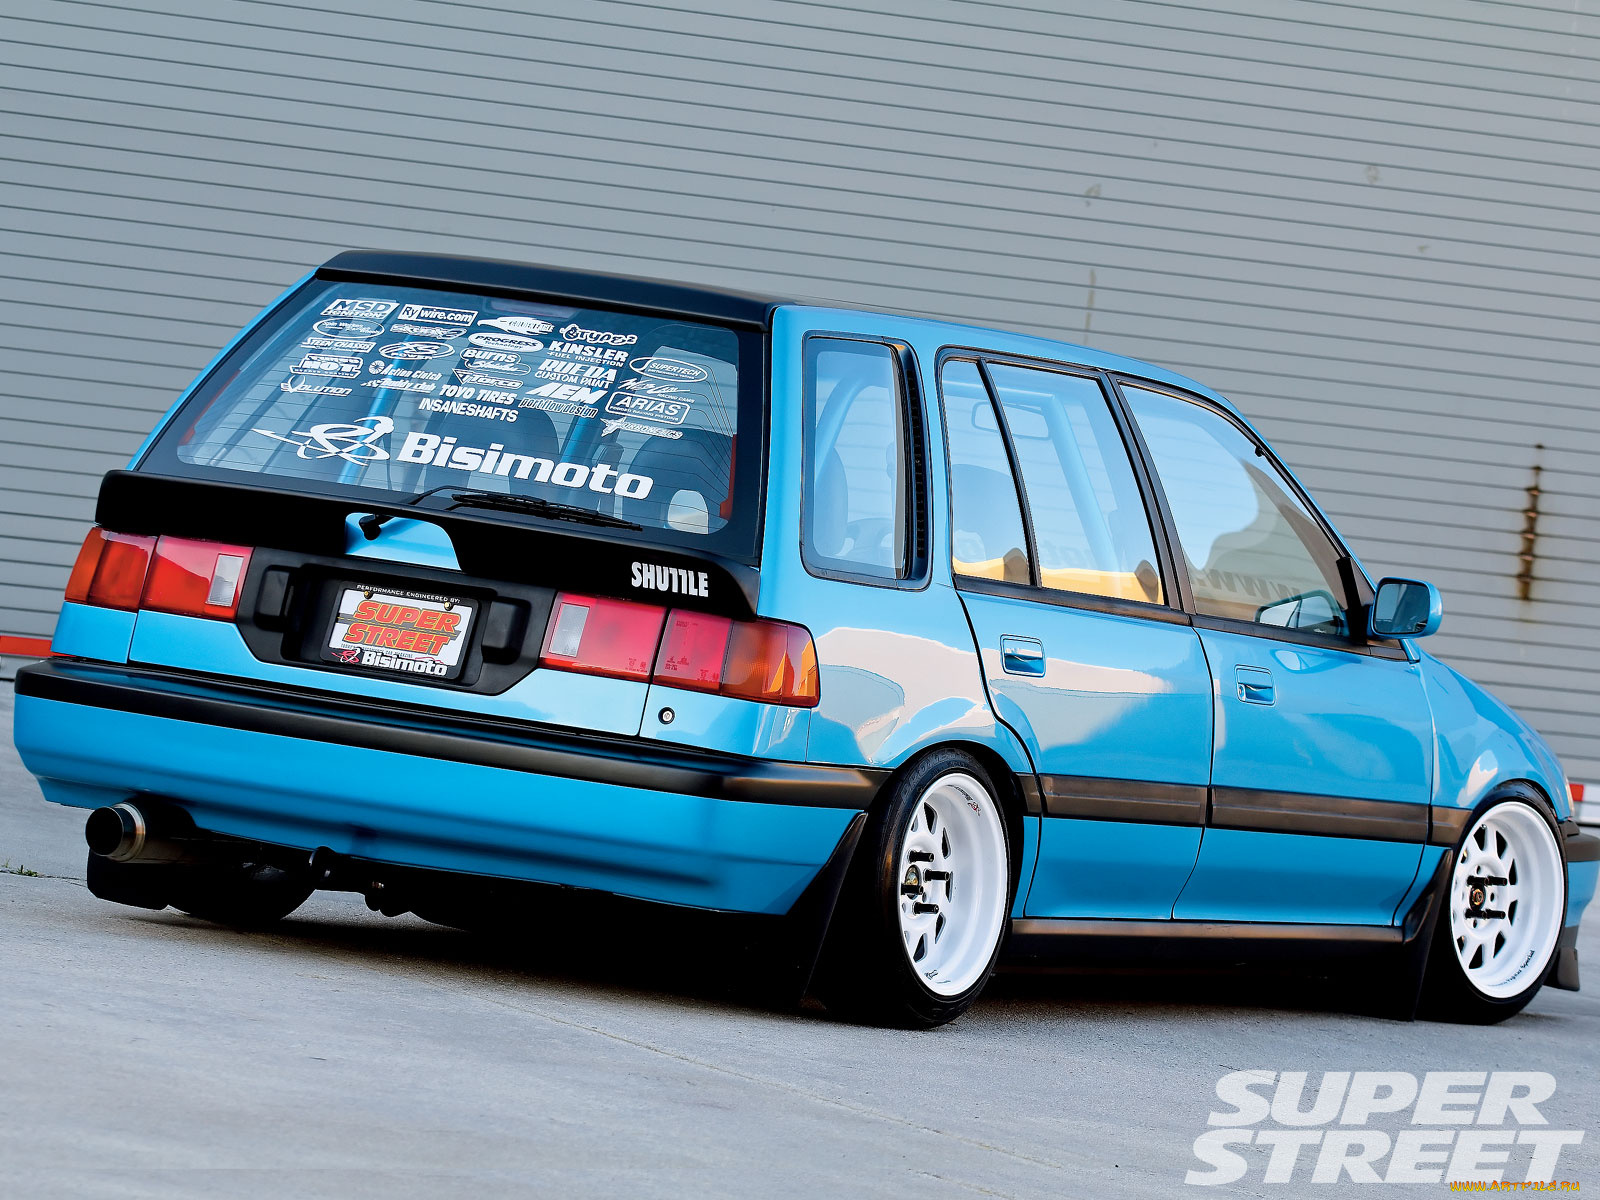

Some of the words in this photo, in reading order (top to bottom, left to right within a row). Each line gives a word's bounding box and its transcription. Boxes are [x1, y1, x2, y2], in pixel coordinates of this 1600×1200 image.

[333, 300, 392, 313] MSD
[475, 335, 539, 347] PROGRESS
[548, 340, 629, 362] KINSLER
[463, 348, 518, 363] Burns
[547, 351, 571, 359] FUEL
[575, 355, 624, 367] INJECTION
[381, 362, 410, 378] Action
[411, 370, 443, 381] Clutch
[534, 370, 579, 384] CUSTOM
[580, 377, 614, 389] PAINT
[538, 358, 618, 382] RUEDA
[650, 362, 702, 377] SUPERTECH
[438, 384, 476, 400] TOYO
[476, 389, 518, 405] TIRES
[525, 381, 609, 405] AEM
[418, 397, 520, 423] INSANESHAFTS
[615, 396, 682, 416] ARIAS
[395, 431, 654, 500] Bisimoto
[631, 561, 709, 598] SHUTTLE
[356, 584, 404, 596] PERFORMANCE
[405, 592, 449, 602] ENGINEERED
[353, 599, 462, 633] SUPER
[342, 622, 452, 657] STREET
[361, 650, 448, 677] Bisimoto
